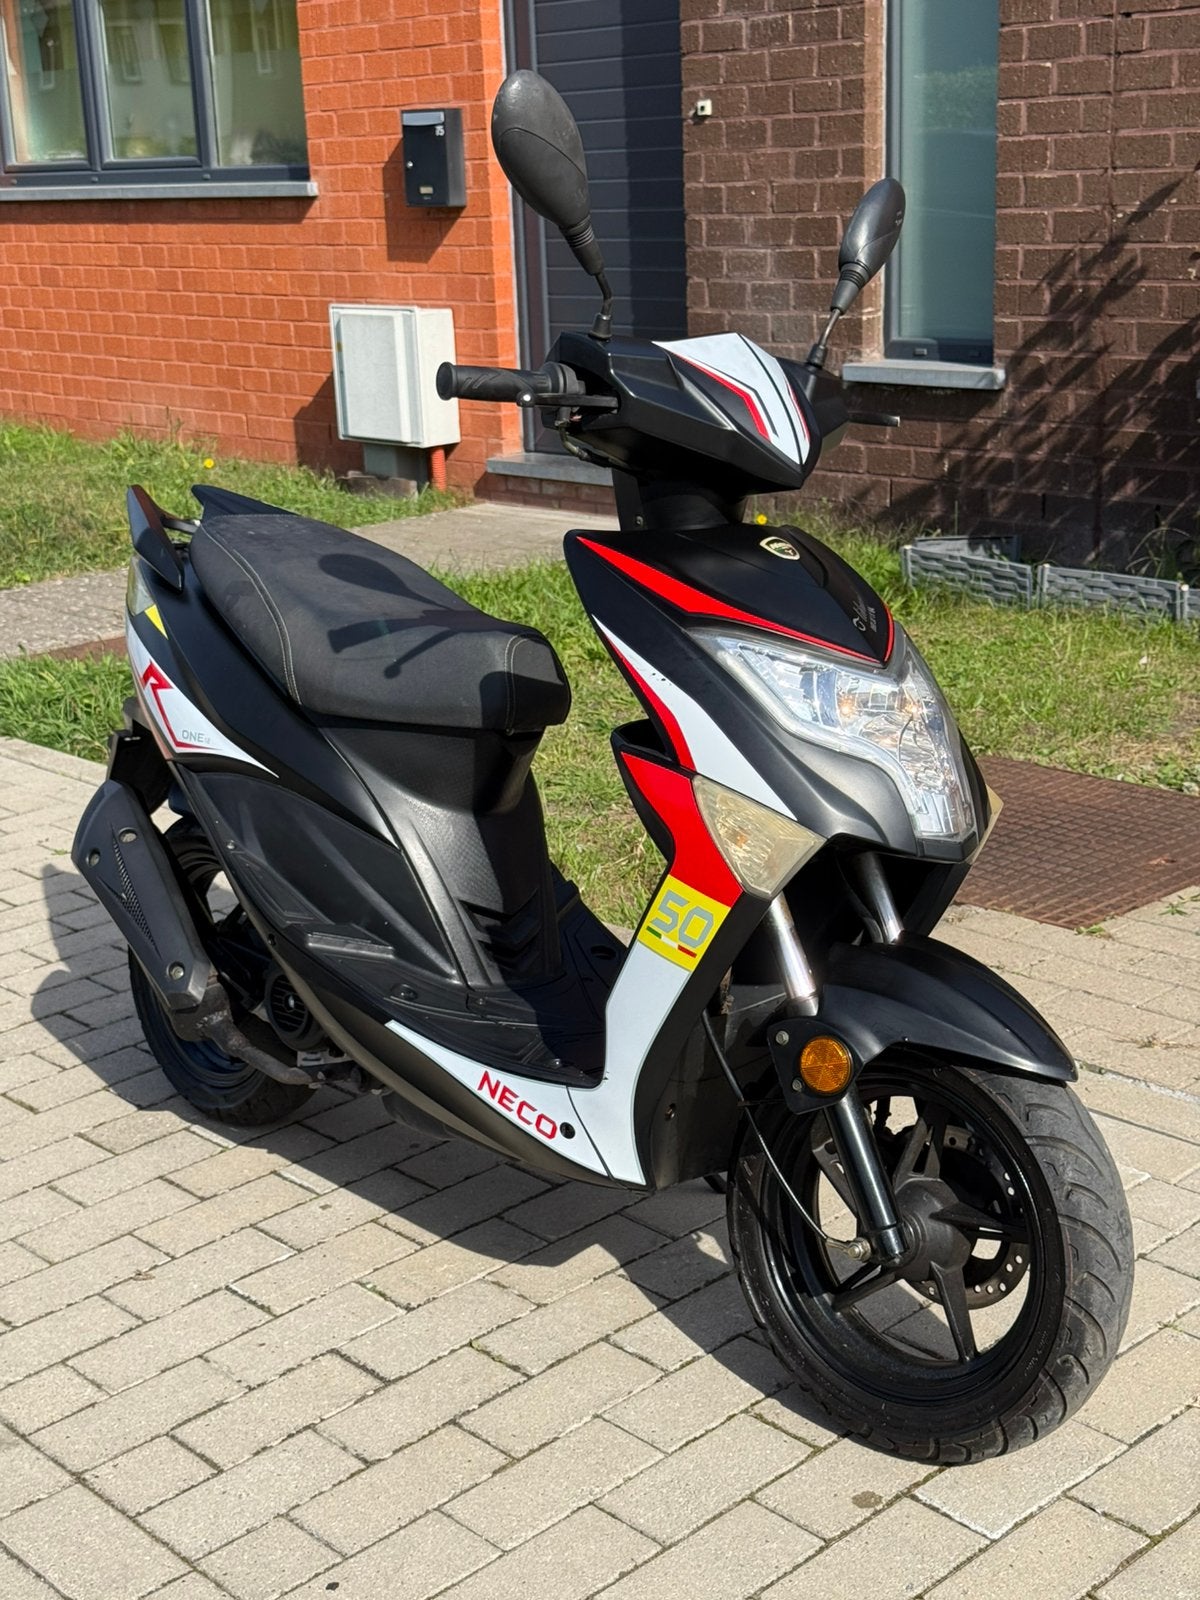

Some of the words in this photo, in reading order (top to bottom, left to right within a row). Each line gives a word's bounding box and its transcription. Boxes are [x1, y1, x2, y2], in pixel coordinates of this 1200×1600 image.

[181, 729, 205, 743] ONE
[651, 889, 715, 949] 50
[477, 1070, 558, 1140] NECO
